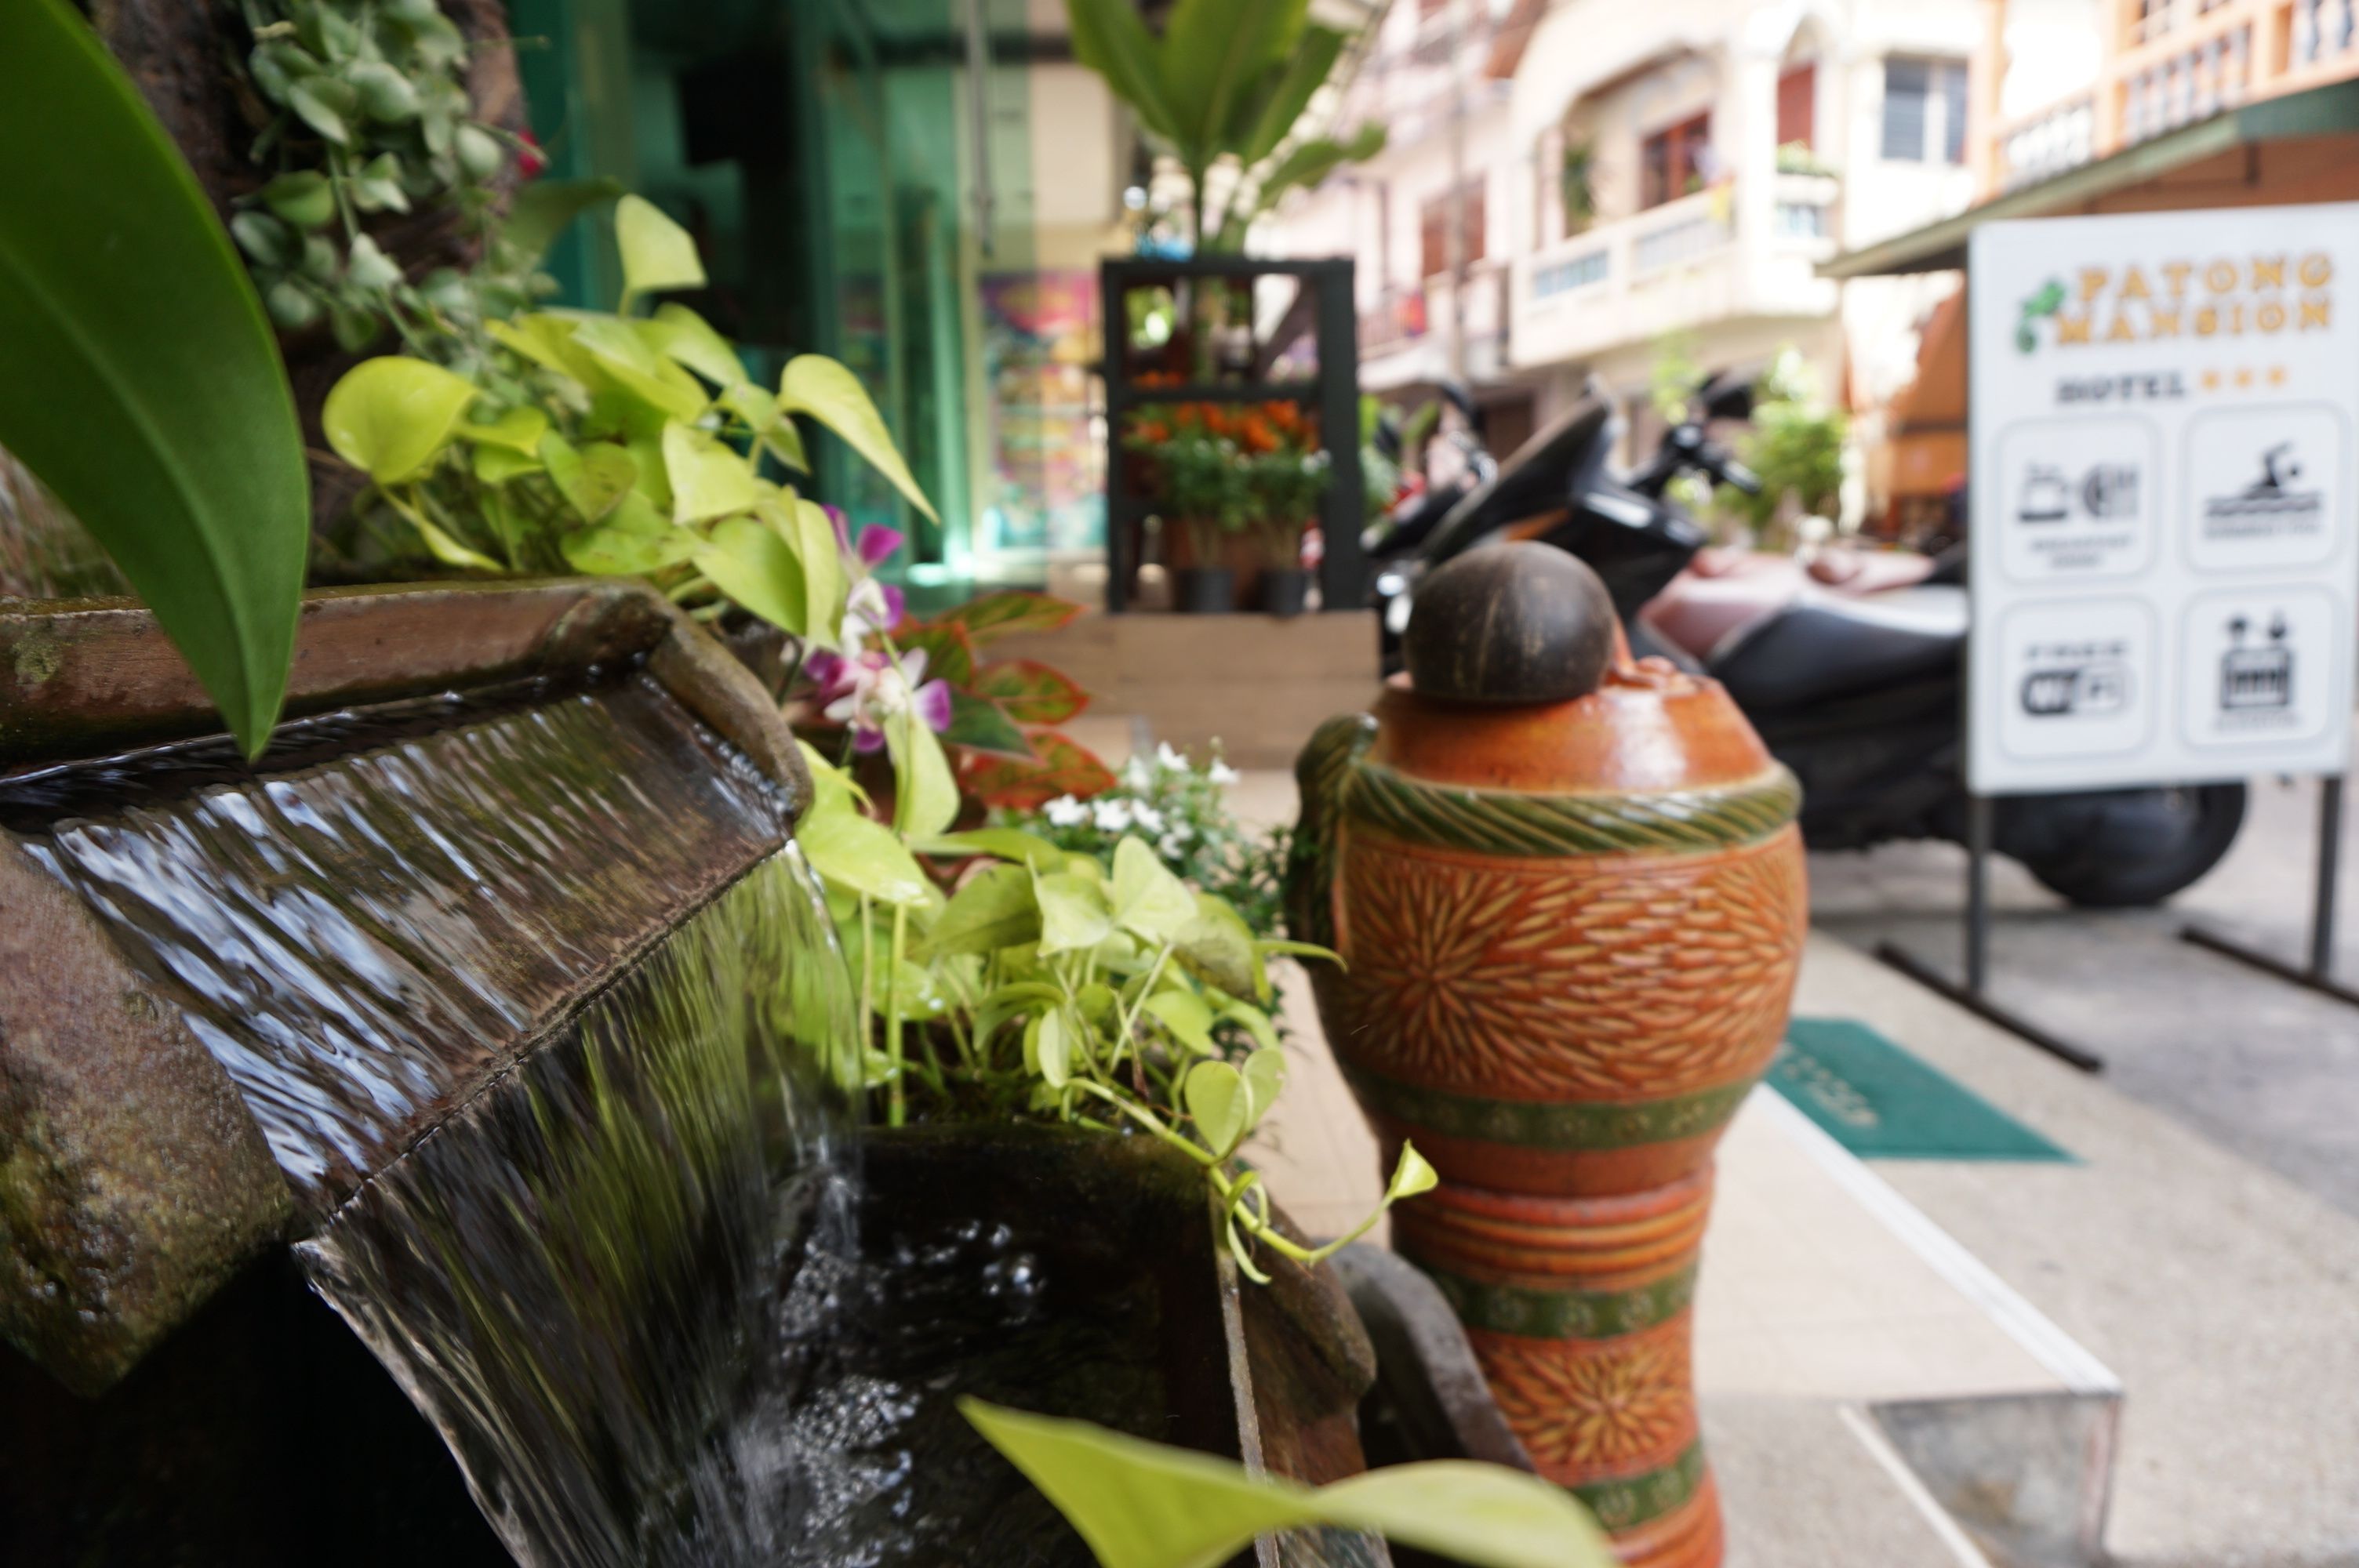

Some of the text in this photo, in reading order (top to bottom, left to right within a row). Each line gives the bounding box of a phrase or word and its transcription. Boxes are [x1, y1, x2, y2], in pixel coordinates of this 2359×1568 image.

[2077, 255, 2333, 303] PATONG
[2055, 299, 2331, 345] MANSION
[2055, 372, 2186, 403] HOTEL
